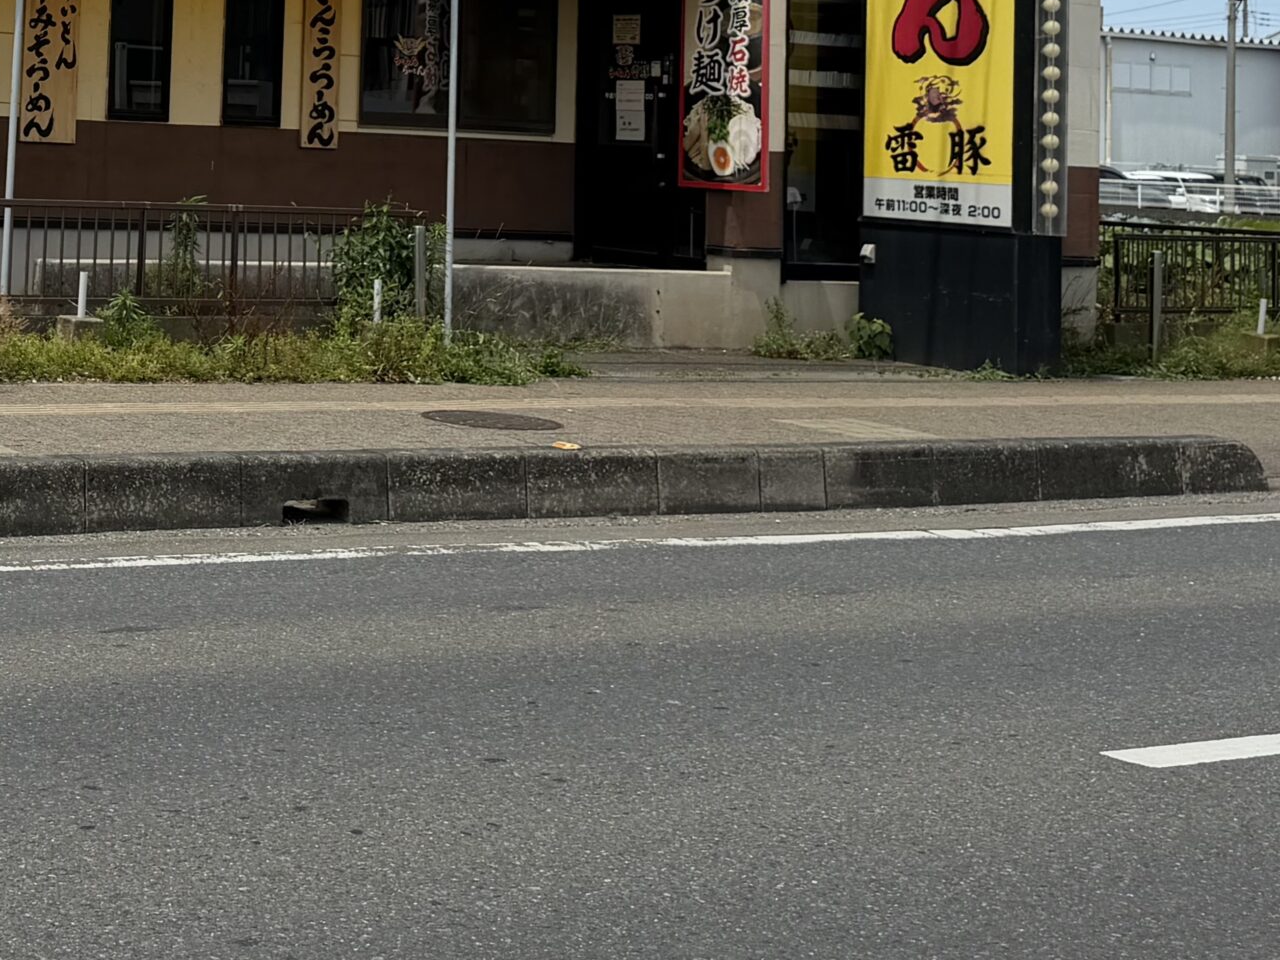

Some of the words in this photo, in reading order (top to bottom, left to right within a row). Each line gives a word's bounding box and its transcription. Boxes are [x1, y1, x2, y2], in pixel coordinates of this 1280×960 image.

[885, 123, 992, 176] 雷豚
[913, 184, 959, 202] 営業時間
[967, 204, 1001, 219] 2:00
